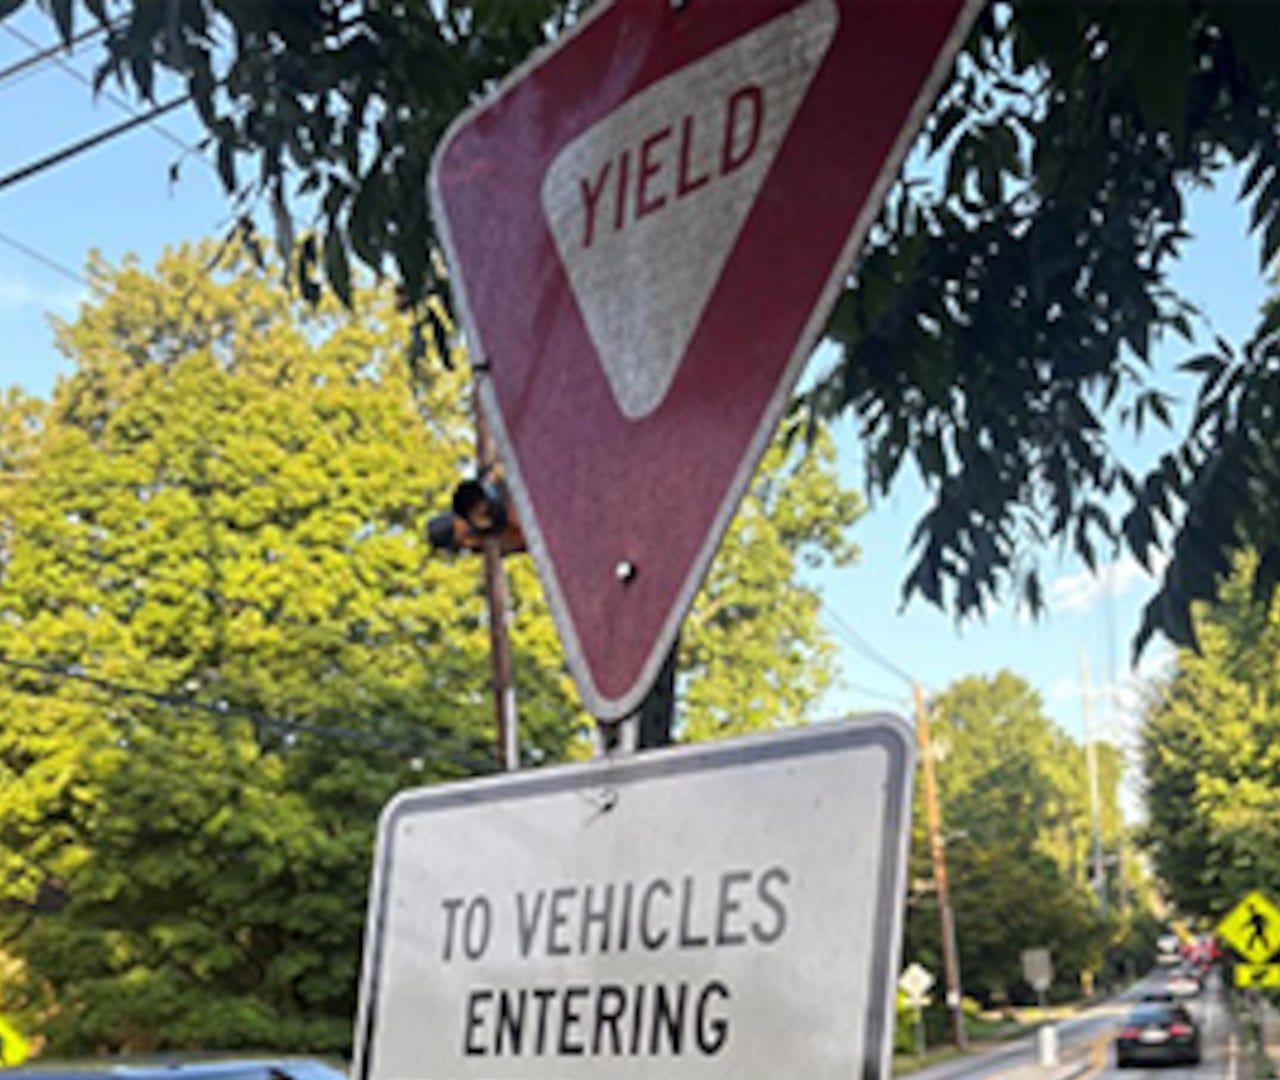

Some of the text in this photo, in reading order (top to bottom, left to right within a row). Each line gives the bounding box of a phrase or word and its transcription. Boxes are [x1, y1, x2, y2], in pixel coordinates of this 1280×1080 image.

[580, 82, 763, 248] YIELD
[441, 866, 790, 962] TO VEHICLES
[463, 980, 731, 1056] ENTERING
